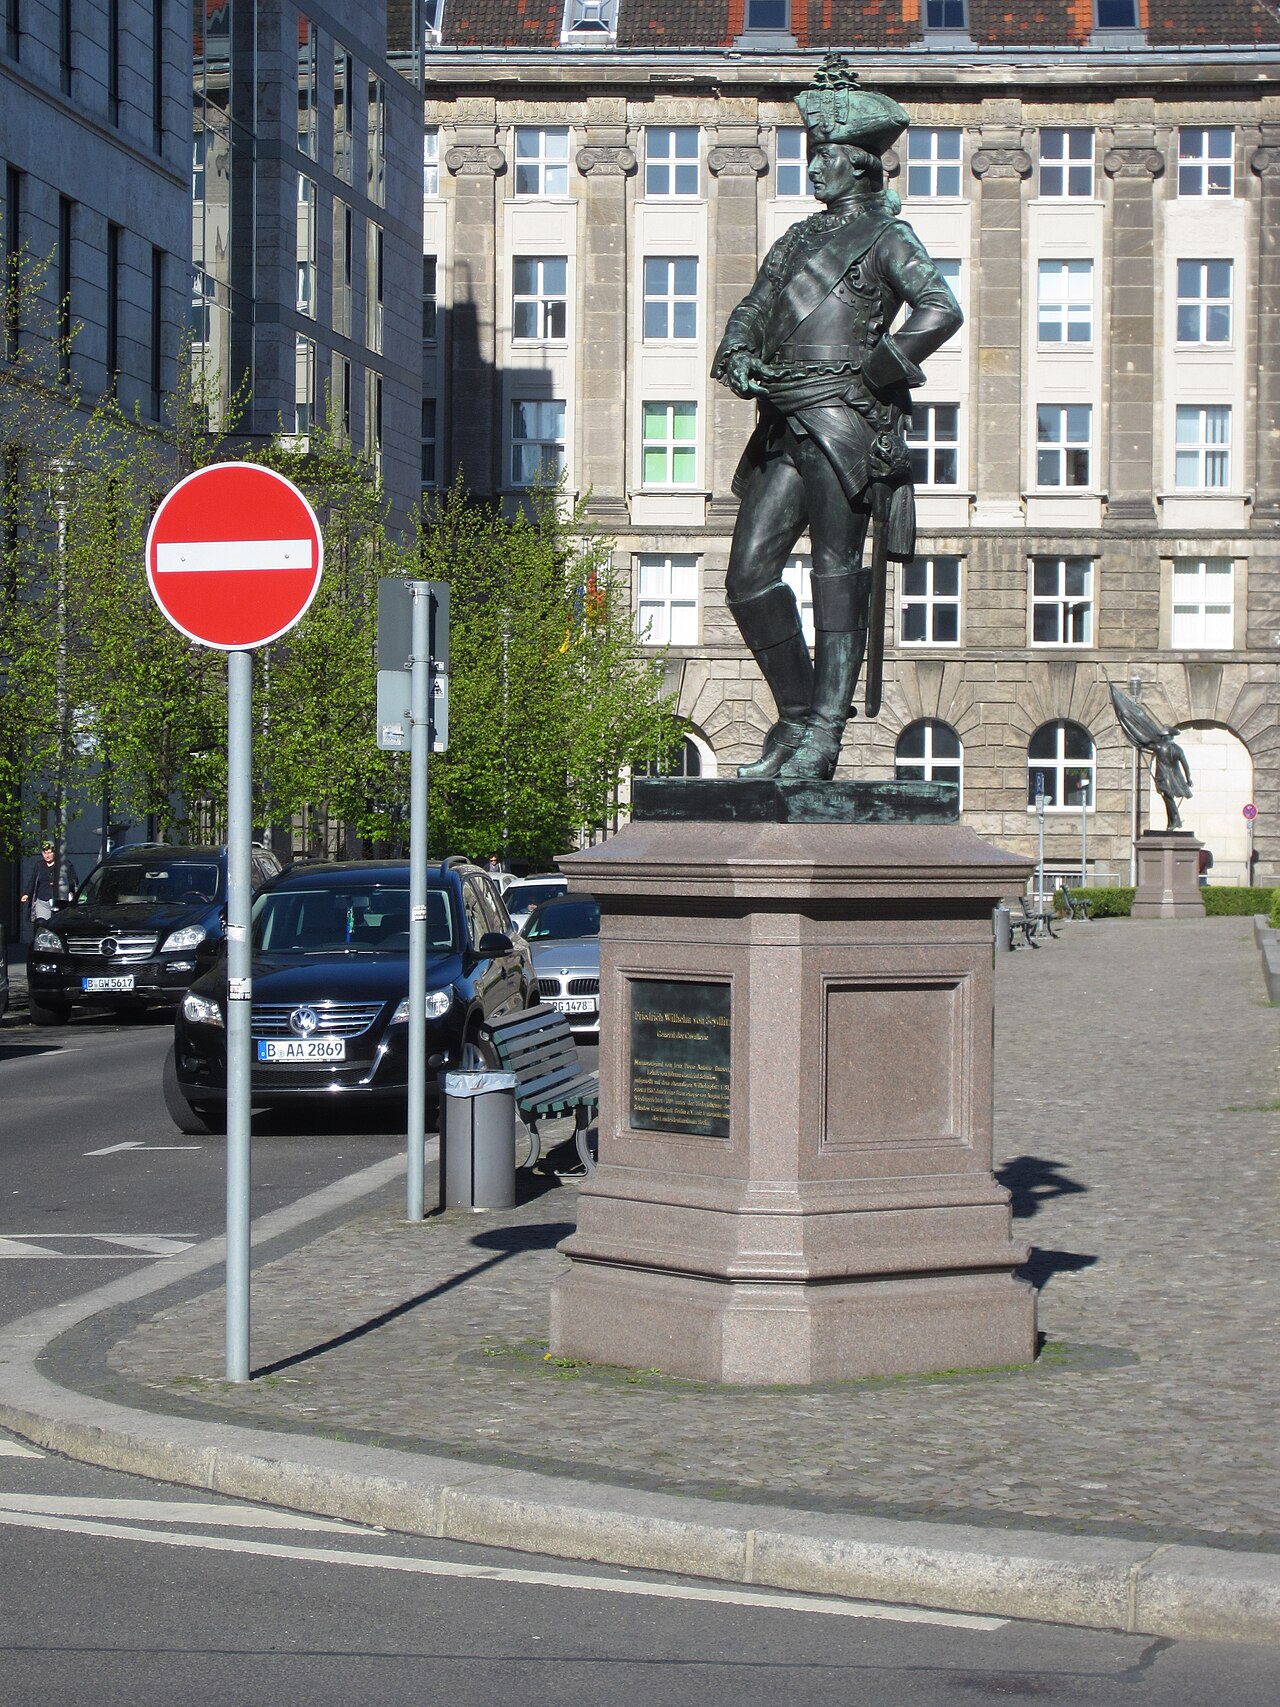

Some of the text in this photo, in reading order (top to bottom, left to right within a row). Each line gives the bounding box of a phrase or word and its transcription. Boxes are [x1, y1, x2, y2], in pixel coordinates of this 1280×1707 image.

[87, 979, 133, 988] B GW 5617
[565, 1001, 587, 1011] 1478
[634, 1011, 663, 1022] Friedrich
[664, 1013, 692, 1024] Wilhelm
[692, 1017, 705, 1025] von
[267, 1043, 343, 1057] B AA 2869
